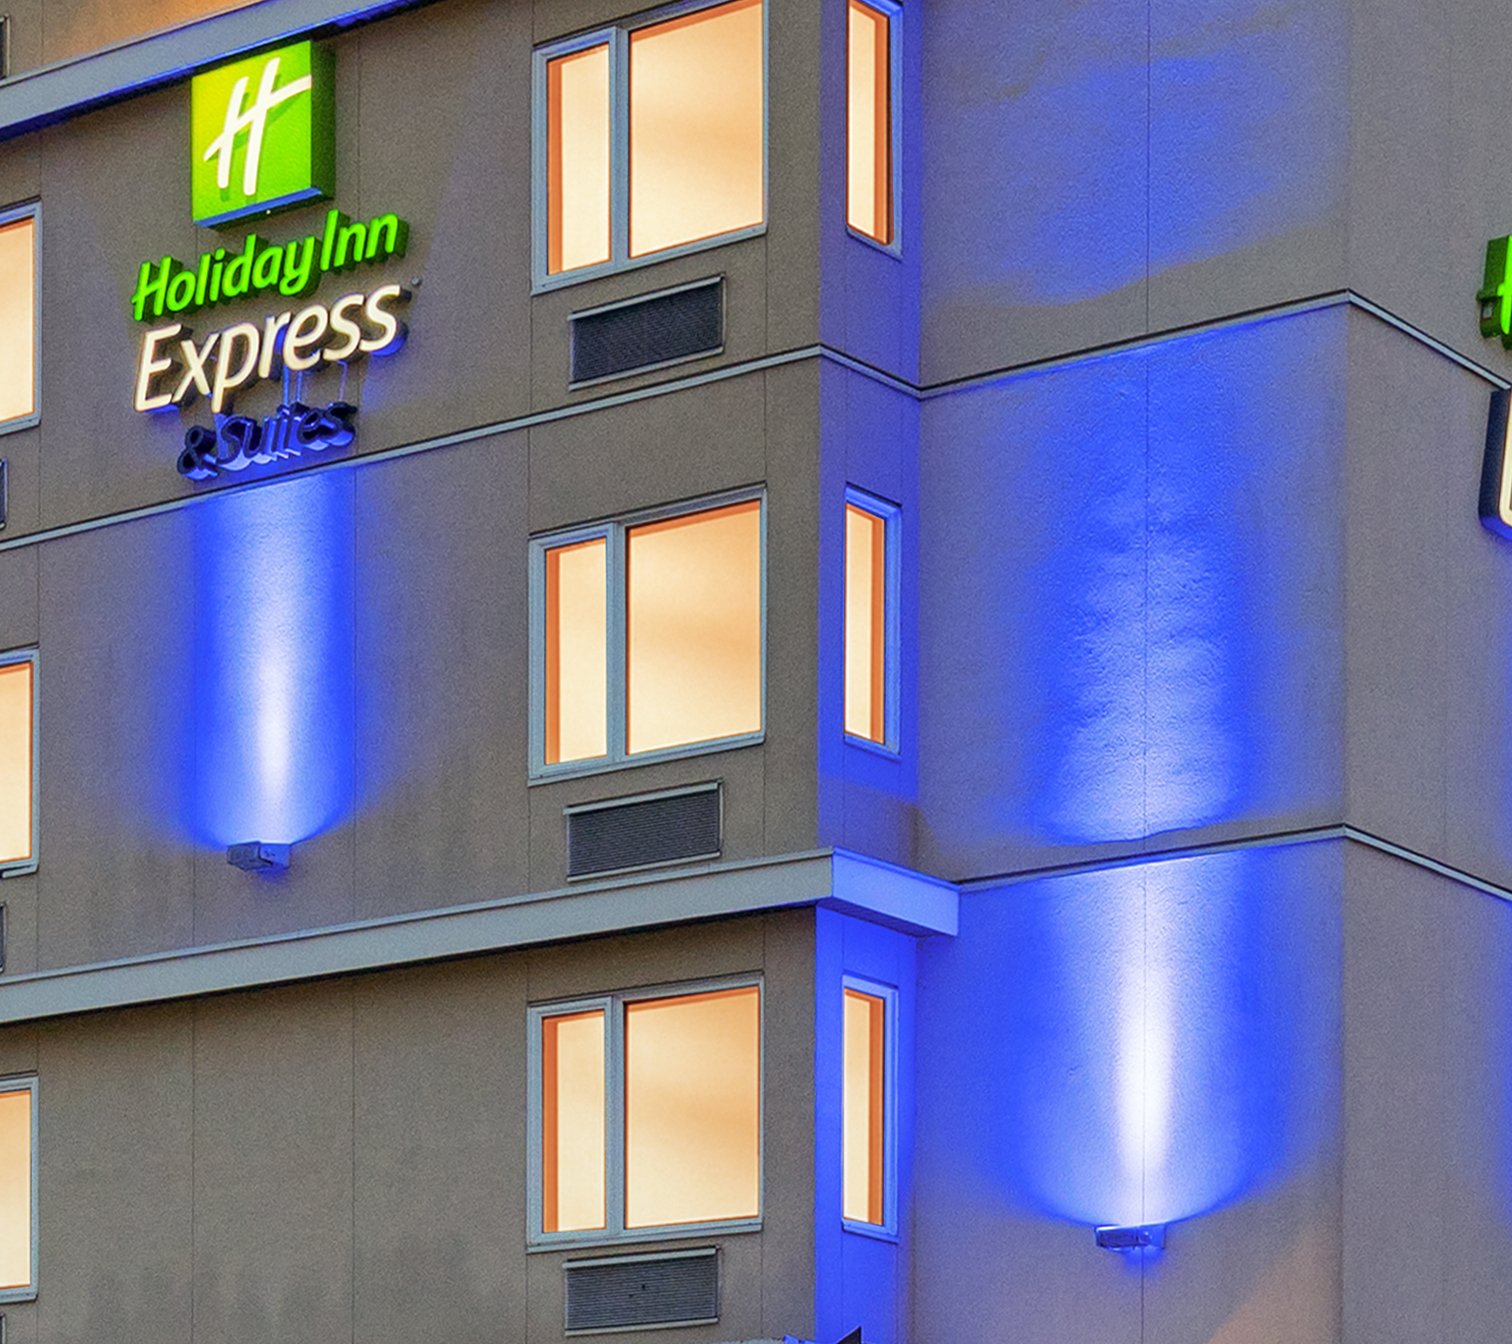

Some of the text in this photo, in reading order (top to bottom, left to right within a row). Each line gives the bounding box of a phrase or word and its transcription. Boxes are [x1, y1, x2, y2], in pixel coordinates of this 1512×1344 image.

[131, 209, 399, 321] Holiday Inn
[133, 285, 401, 413] Express
[178, 402, 356, 479] & Suites
